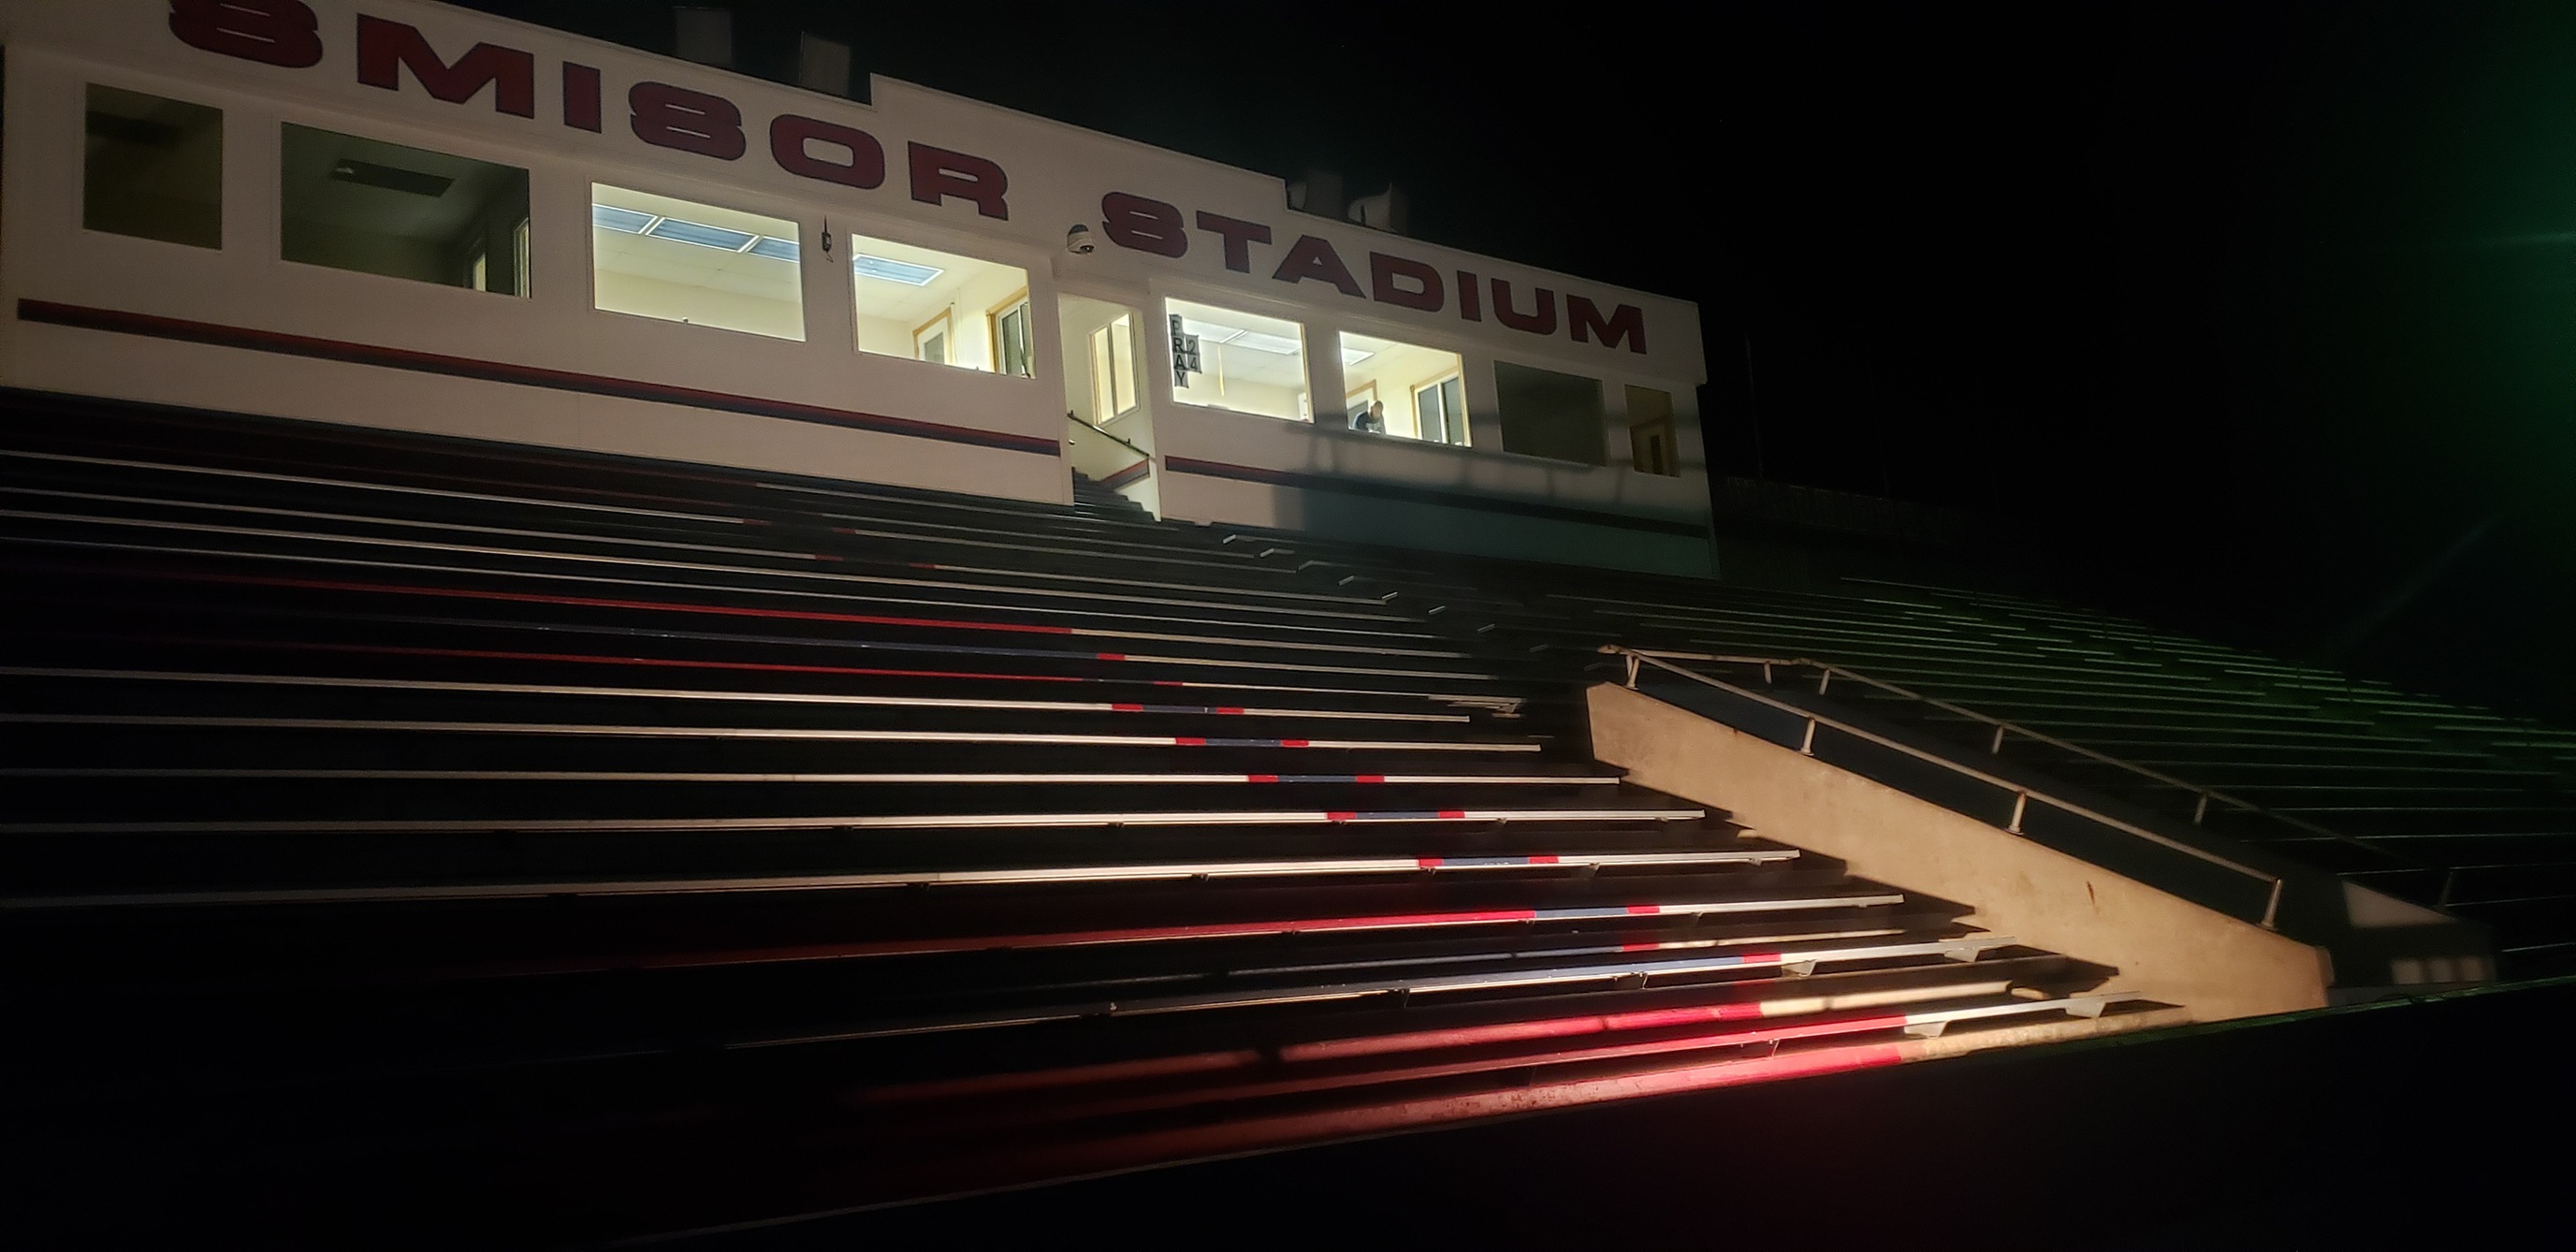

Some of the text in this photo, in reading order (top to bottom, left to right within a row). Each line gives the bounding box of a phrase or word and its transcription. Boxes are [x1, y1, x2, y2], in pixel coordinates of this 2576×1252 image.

[168, 0, 1647, 355] SMISOR STADIUM
[1172, 319, 1186, 386] PRAY
[1188, 340, 1199, 371] 24
